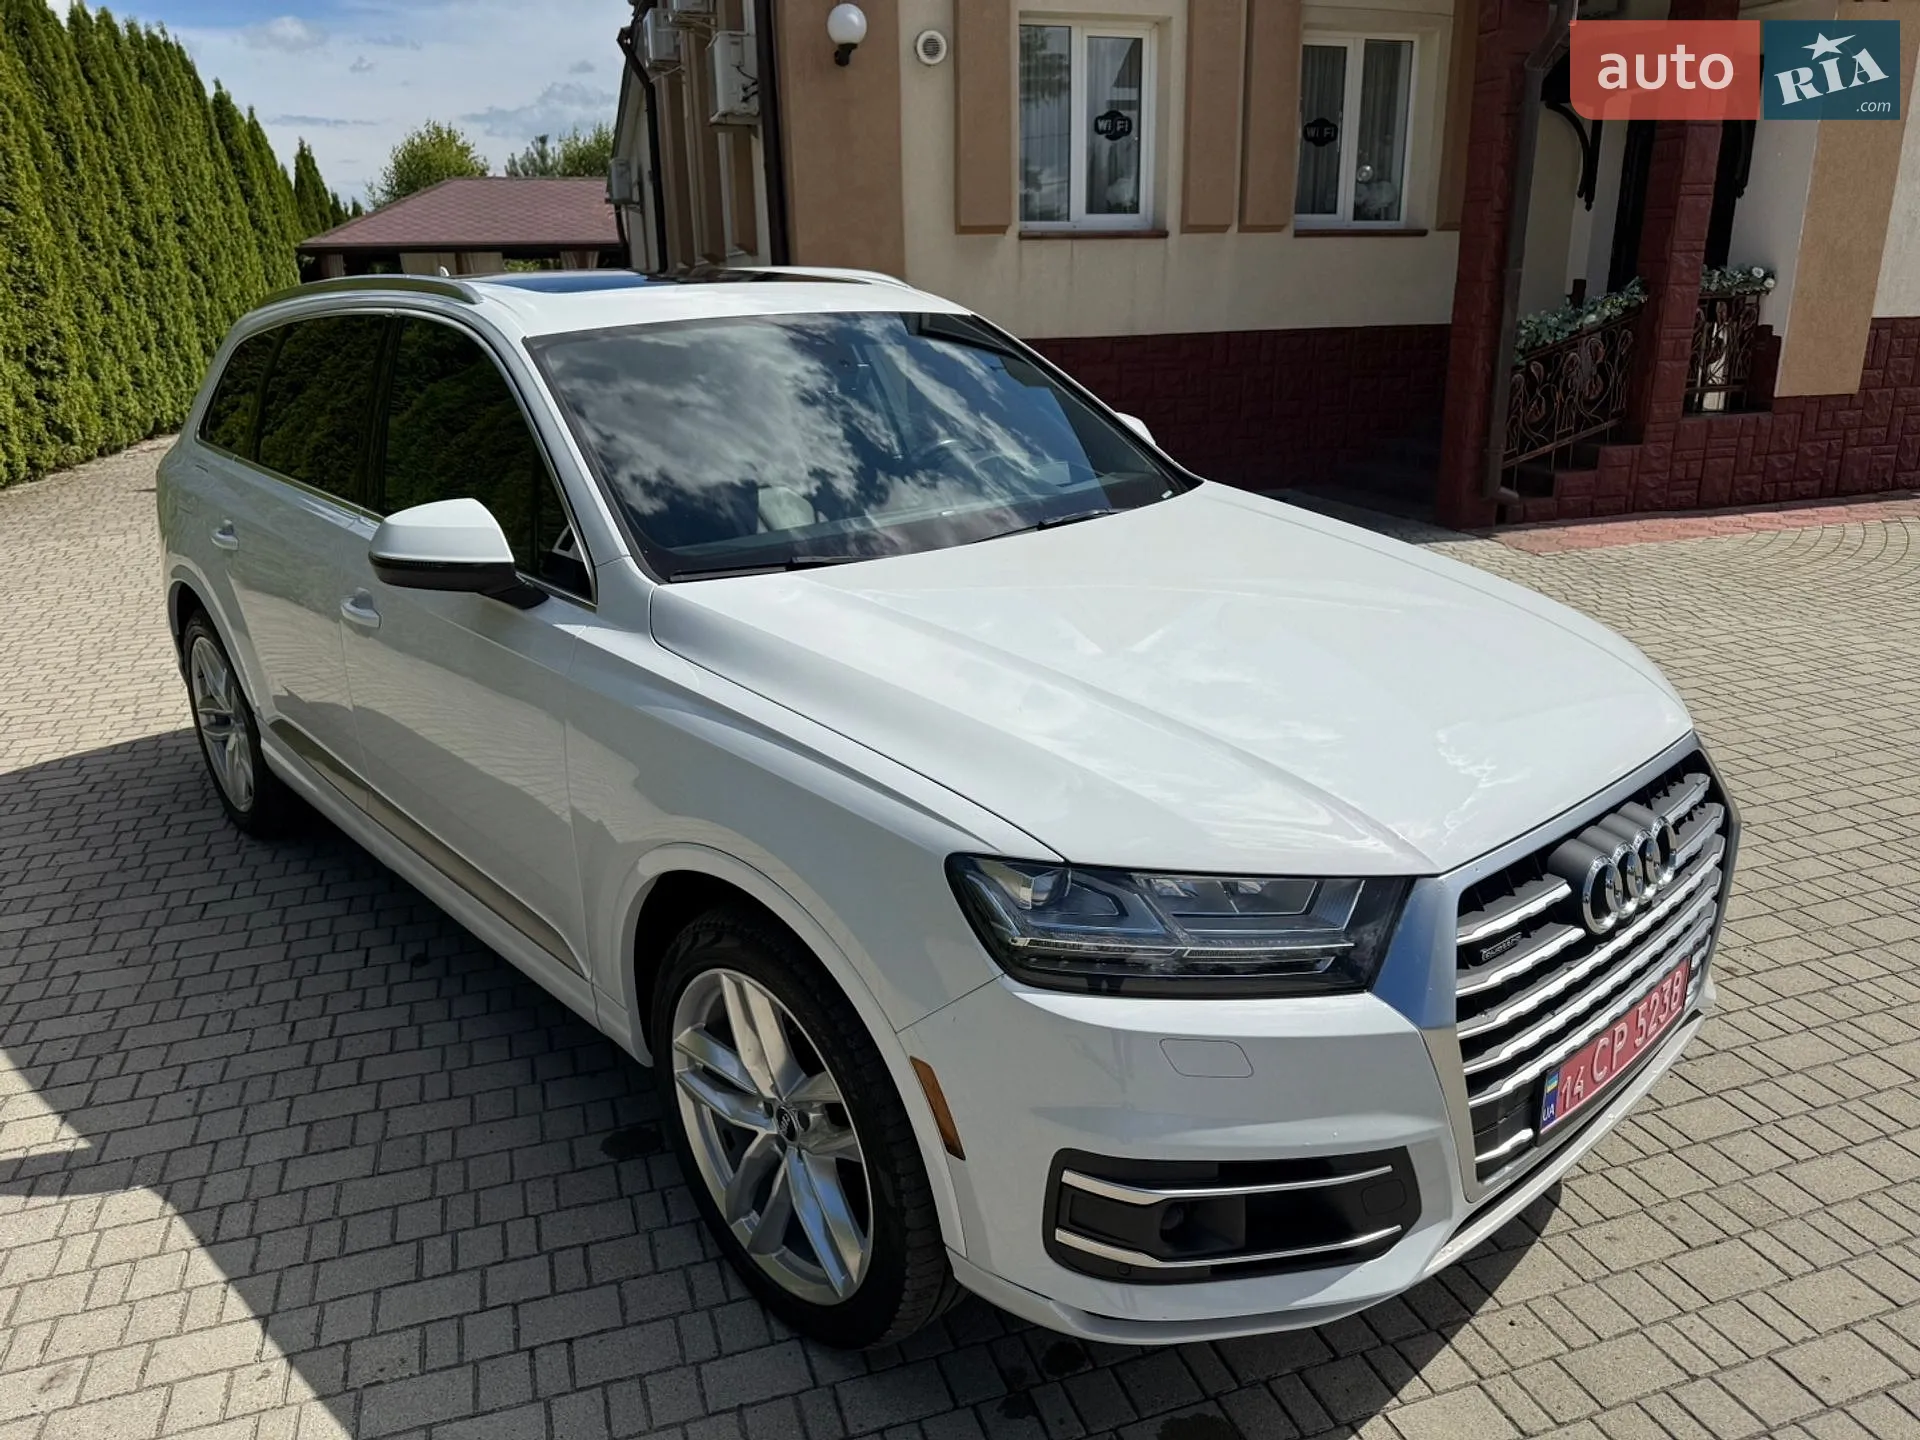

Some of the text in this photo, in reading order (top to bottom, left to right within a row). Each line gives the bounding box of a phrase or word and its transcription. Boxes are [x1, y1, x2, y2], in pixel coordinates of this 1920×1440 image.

[1561, 970, 1682, 1109] 14 CP 5238
[1542, 1104, 1555, 1121] UA
